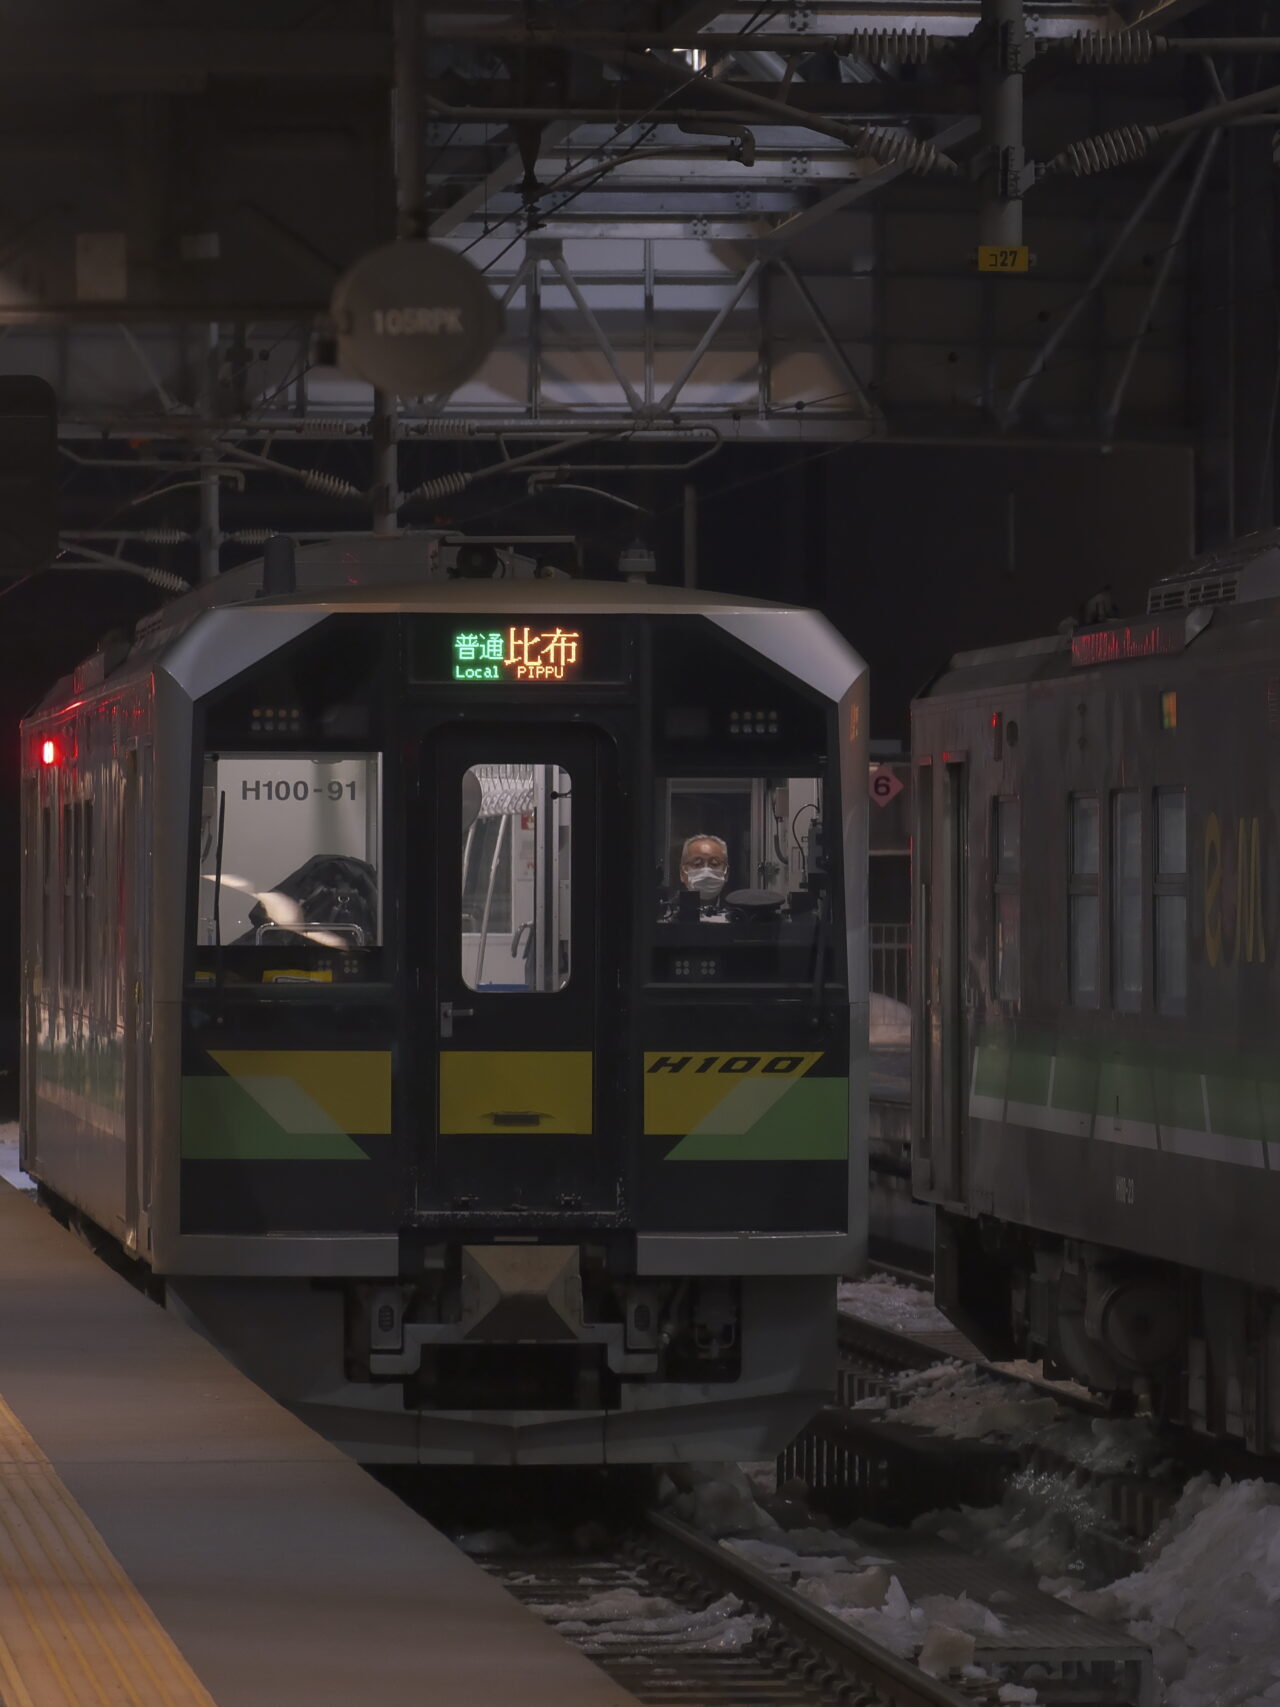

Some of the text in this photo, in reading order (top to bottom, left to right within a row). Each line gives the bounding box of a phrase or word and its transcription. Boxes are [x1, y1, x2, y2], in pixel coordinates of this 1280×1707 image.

[455, 627, 580, 666] 普通 比布
[455, 665, 564, 679] Local PIPPU
[241, 780, 357, 801] H100-91
[874, 776, 891, 796] 6
[646, 1056, 805, 1074] H100
